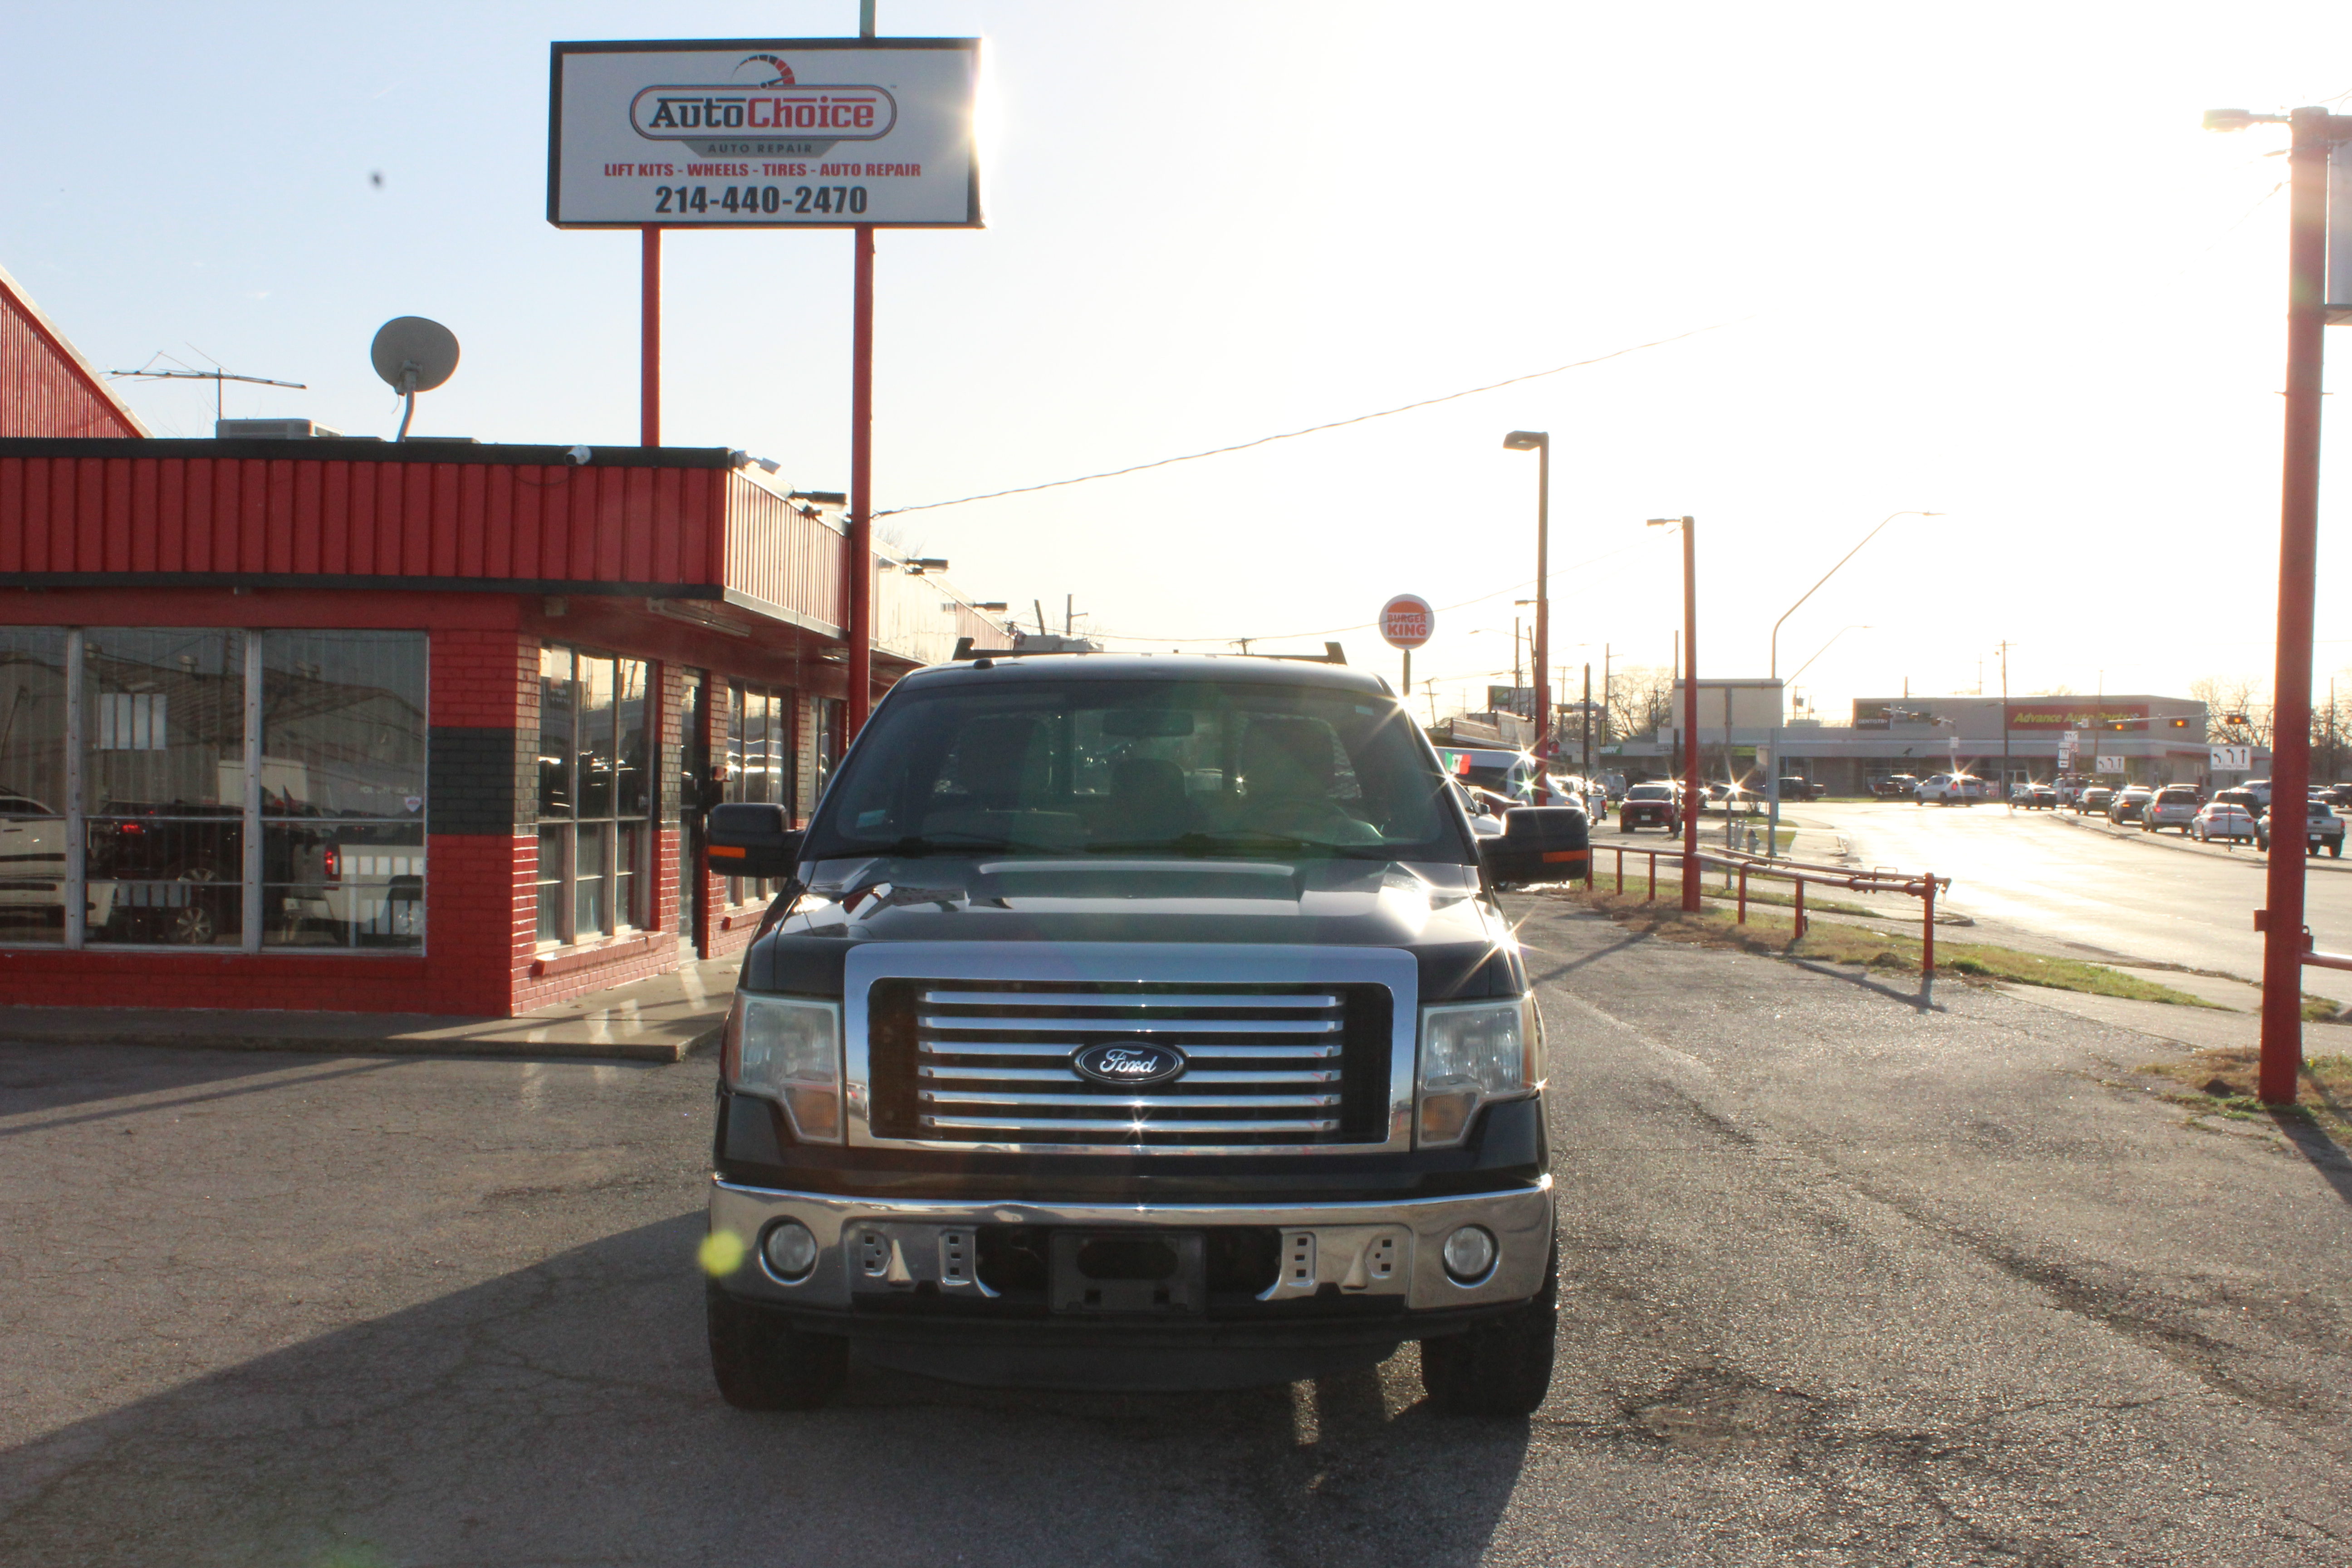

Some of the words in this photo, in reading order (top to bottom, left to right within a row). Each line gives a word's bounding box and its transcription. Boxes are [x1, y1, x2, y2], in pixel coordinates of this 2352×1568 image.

[649, 96, 877, 128] AutoChoice
[708, 144, 750, 153] AUTO
[757, 144, 812, 153] REPAIR
[605, 164, 634, 176] LIFT
[638, 164, 674, 176] KITS
[687, 164, 749, 176] WHEELS
[762, 164, 807, 176] TIRES
[820, 164, 862, 176] AUTO
[866, 164, 921, 176] REPAIR
[655, 186, 867, 214] 214-440-2470
[1387, 614, 1426, 623] BURGER
[1387, 623, 1426, 636] KING
[2014, 712, 2063, 723] Advance
[1100, 1049, 1158, 1073] Ford
